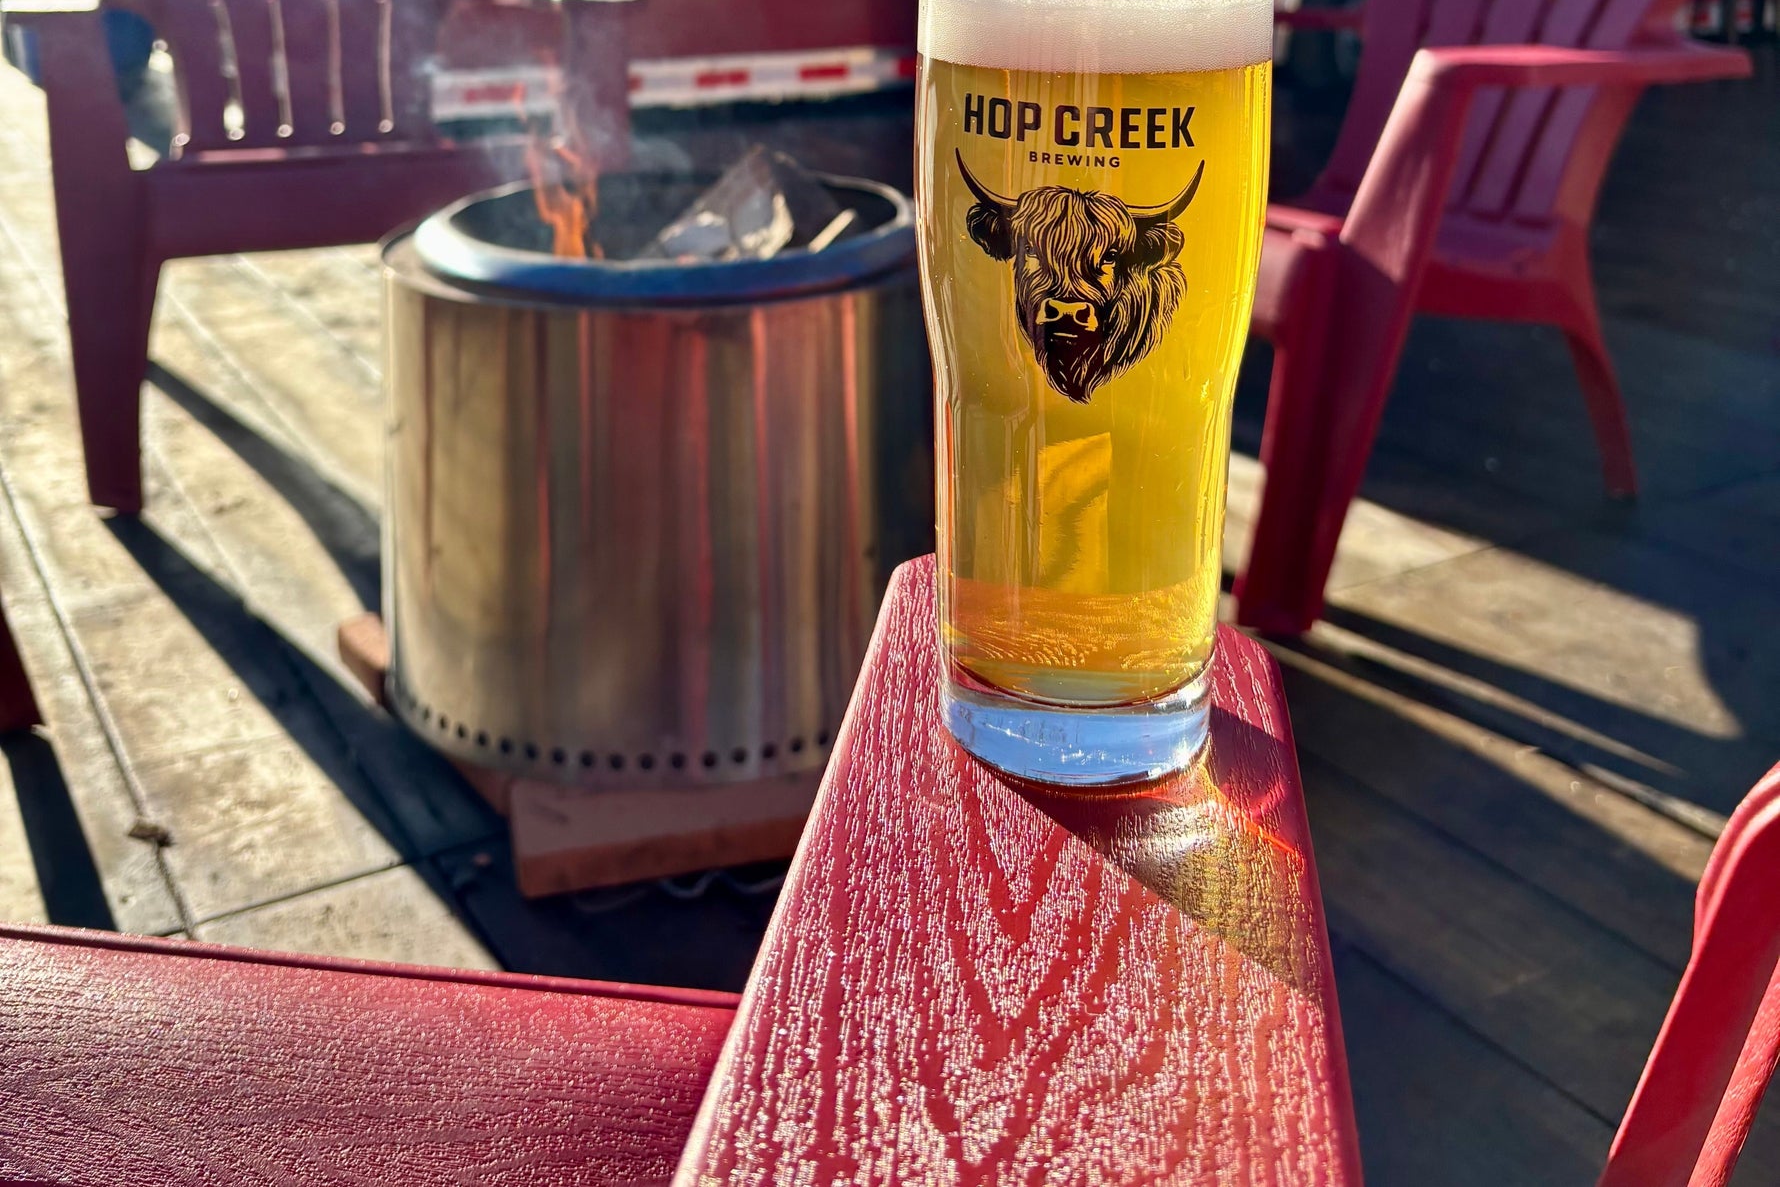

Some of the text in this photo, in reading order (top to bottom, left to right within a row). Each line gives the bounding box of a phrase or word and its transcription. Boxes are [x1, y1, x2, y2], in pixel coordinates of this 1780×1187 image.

[964, 93, 1196, 149] HOP CREEK
[1029, 150, 1120, 168] BREWING
